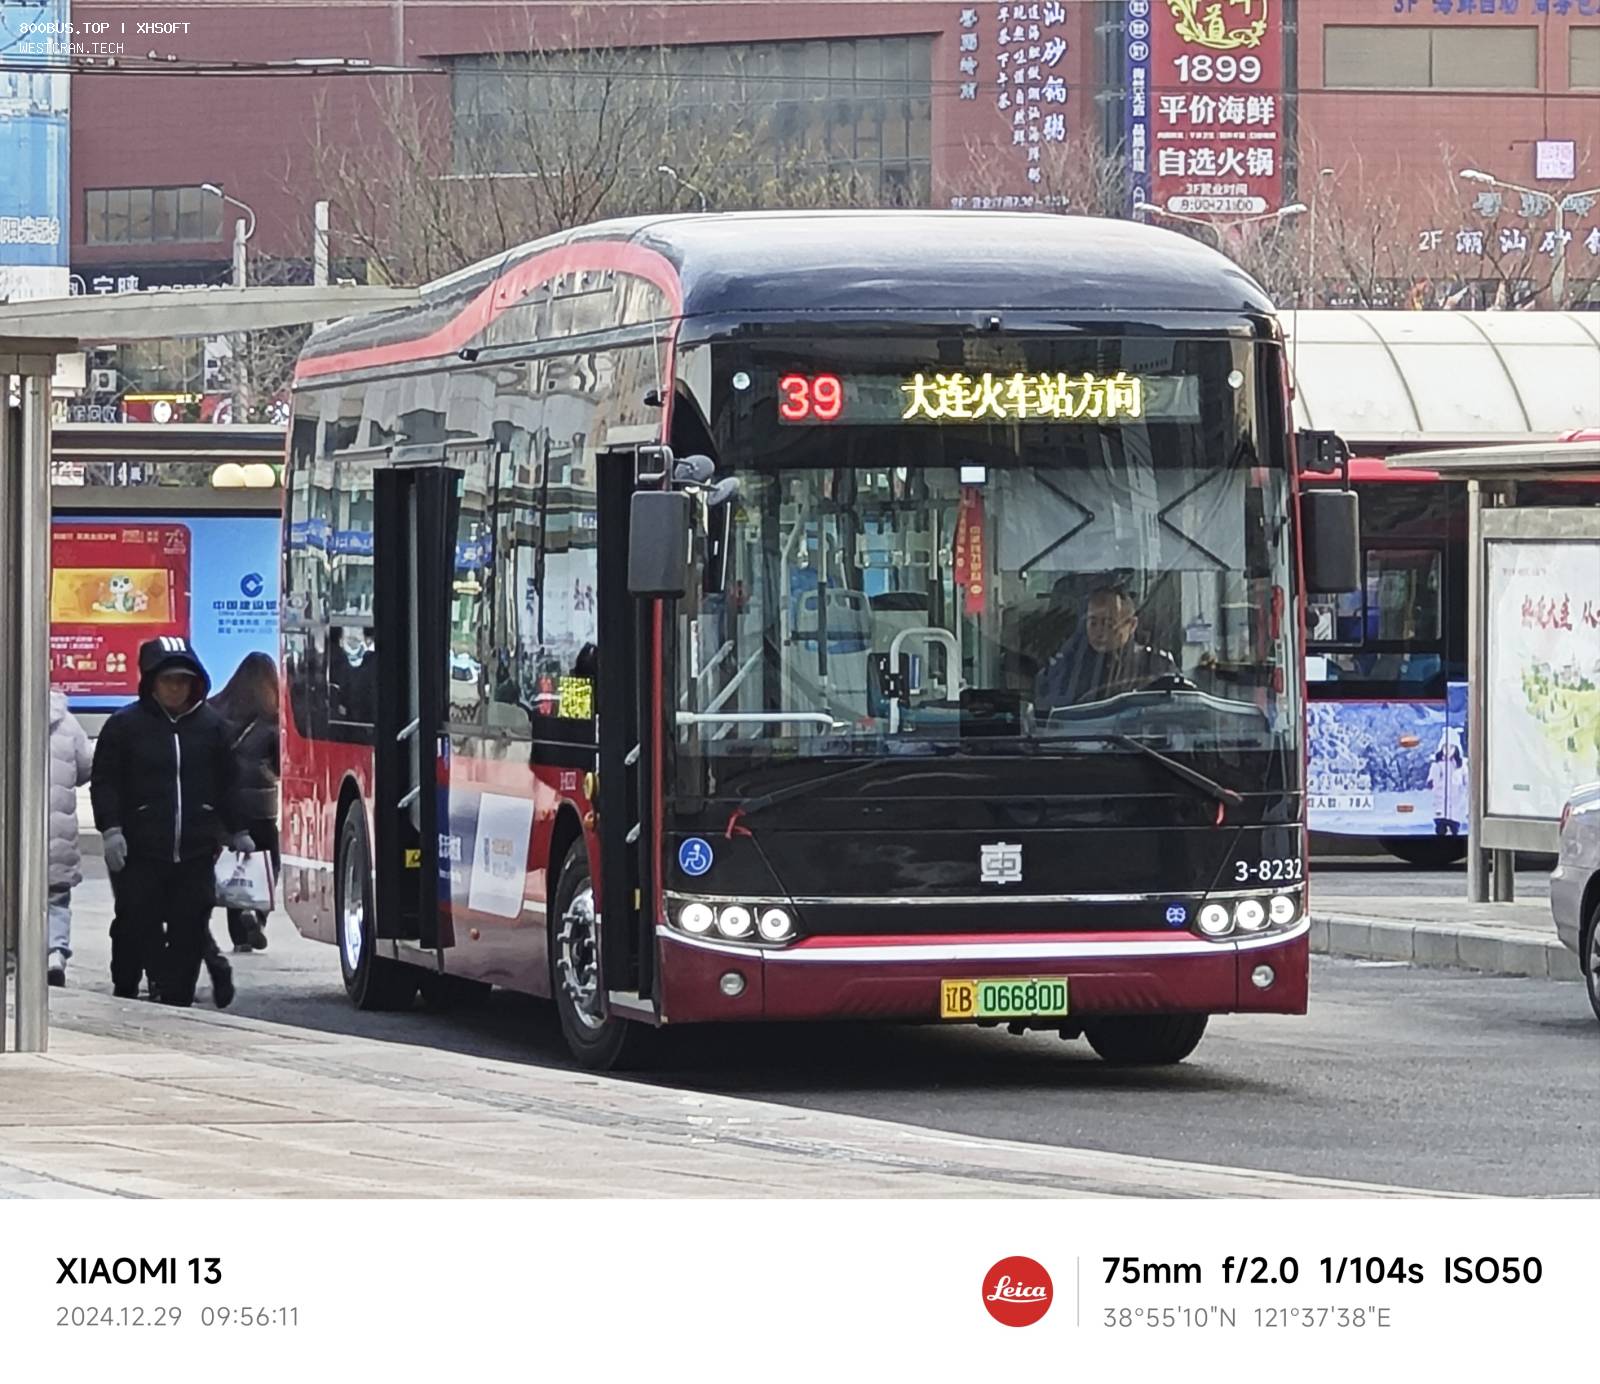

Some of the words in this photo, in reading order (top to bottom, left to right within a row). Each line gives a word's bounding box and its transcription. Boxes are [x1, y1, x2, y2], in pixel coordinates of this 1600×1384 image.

[1173, 54, 1261, 83] 1899
[1159, 95, 1275, 125] 平价海鲜
[1159, 146, 1274, 176] 自选火锅
[780, 374, 842, 420] 39
[901, 371, 1142, 419] 大连火车站方向
[1234, 858, 1302, 882] 3-8232
